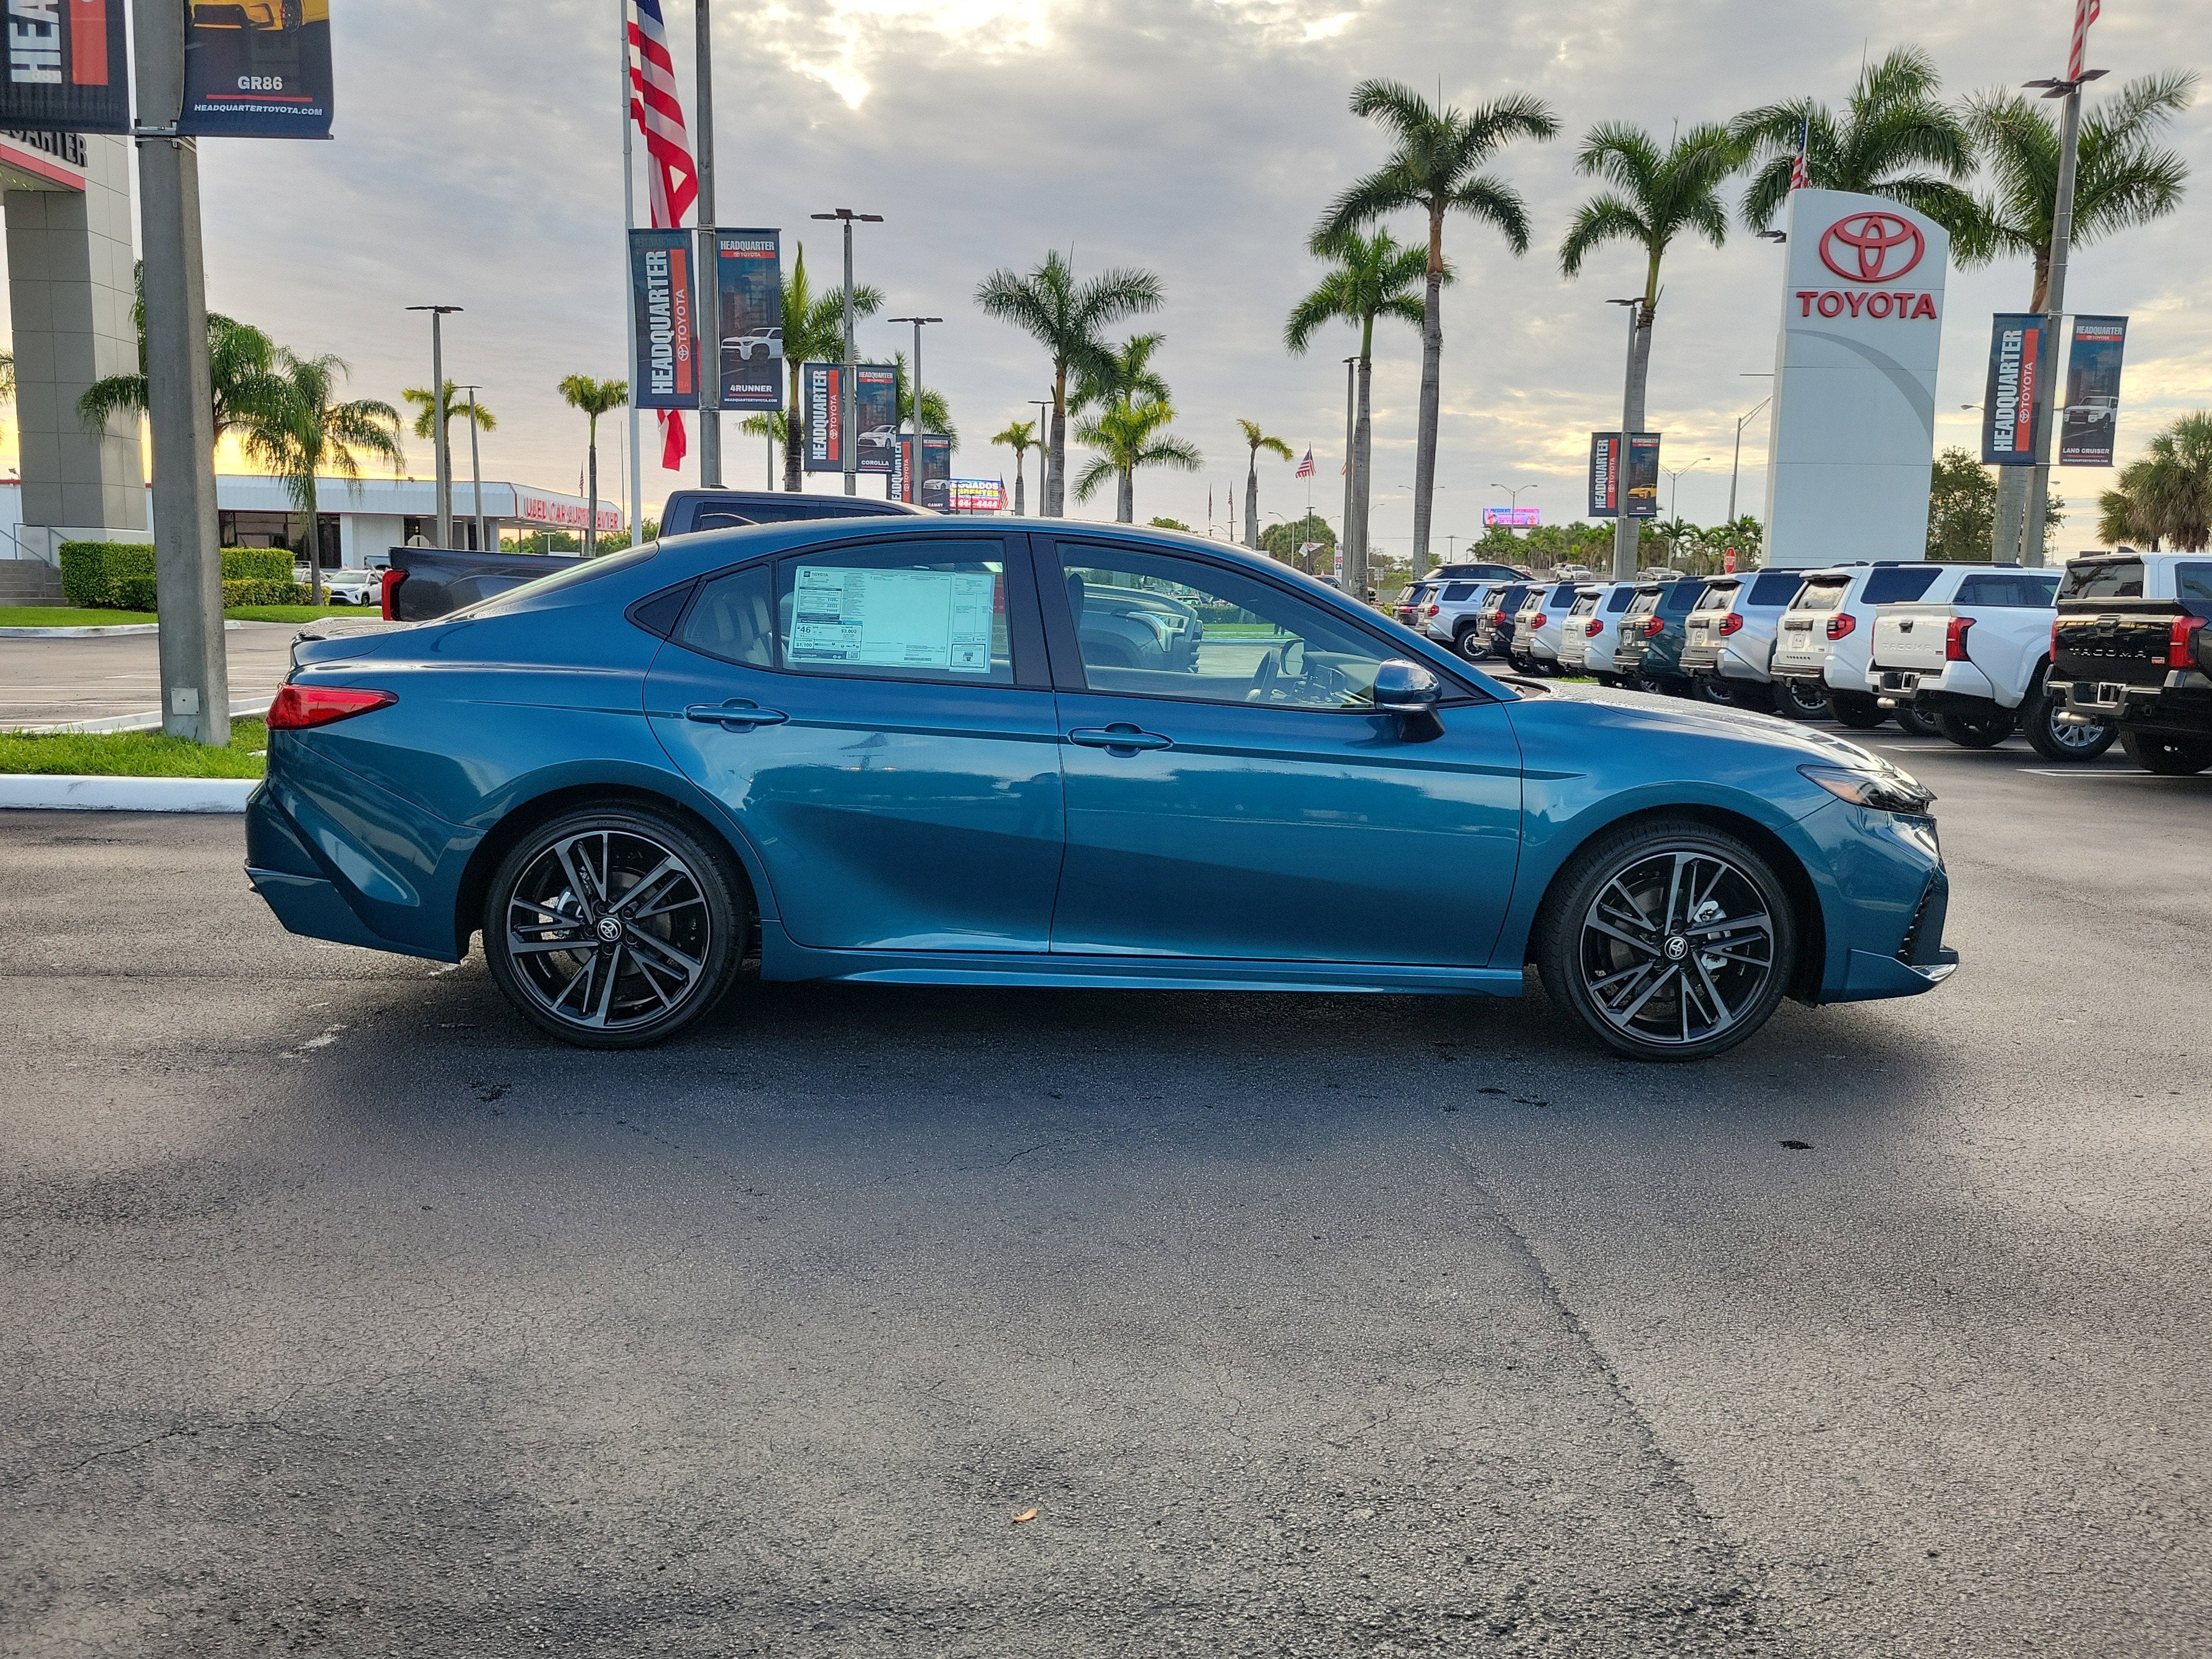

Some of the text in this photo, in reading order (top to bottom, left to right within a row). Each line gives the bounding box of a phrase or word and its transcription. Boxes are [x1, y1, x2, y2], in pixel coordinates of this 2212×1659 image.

[238, 76, 283, 90] GR86
[194, 104, 323, 115] HEADQUARTERTOYOTA.COM
[720, 240, 775, 251] HEADQUARTER
[676, 289, 687, 343] TOYOTA
[1796, 291, 1937, 319] TOYOTA
[646, 250, 674, 394] HEADQUARTER
[2076, 326, 2123, 335] HEADQUARTER
[1994, 330, 2022, 452] HEADQUARTER
[2021, 362, 2033, 408] TOYOTA
[812, 370, 829, 460] HEADQUARTER
[891, 442, 904, 500] EADQUARTER
[950, 481, 999, 489] BOGADOS
[1595, 439, 1609, 509] HEADQUARTER
[526, 498, 618, 528] USED CAR SUPERENTER
[1725, 556, 1735, 566] STOP
[1882, 643, 1932, 652] TACOMA
[2069, 648, 2147, 658] TACOMA
